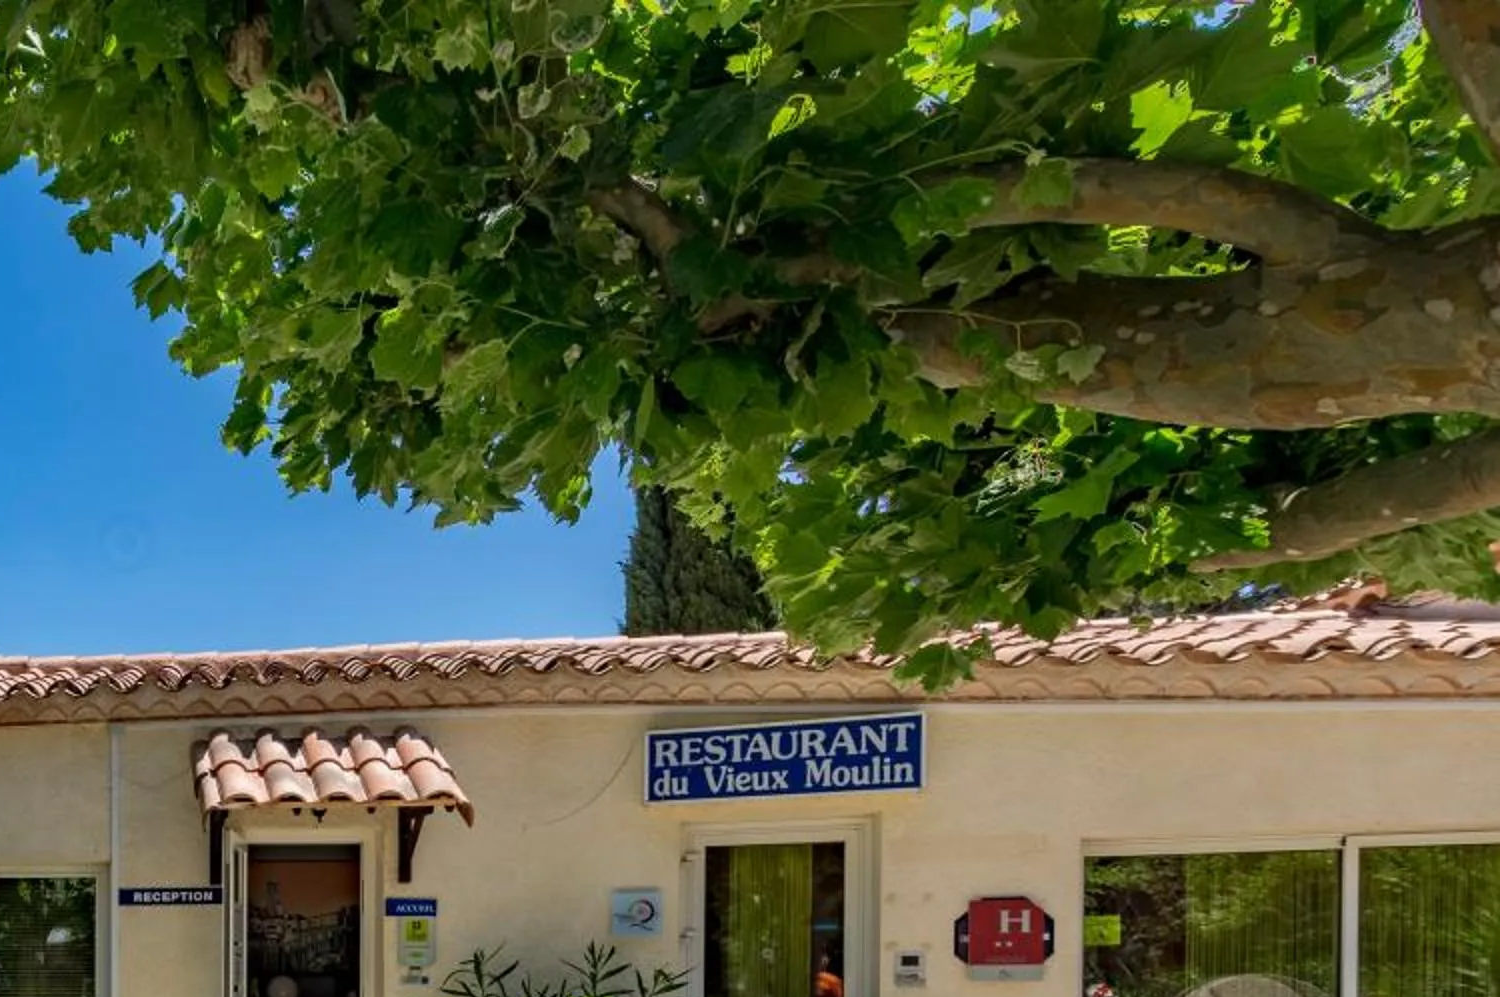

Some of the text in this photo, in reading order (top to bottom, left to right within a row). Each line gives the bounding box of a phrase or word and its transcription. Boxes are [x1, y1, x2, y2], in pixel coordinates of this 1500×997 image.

[653, 722, 915, 768] RESTAURANT
[653, 755, 915, 797] du Vieux Moulin
[133, 891, 213, 902] RECEPTION
[1000, 909, 1032, 933] H
